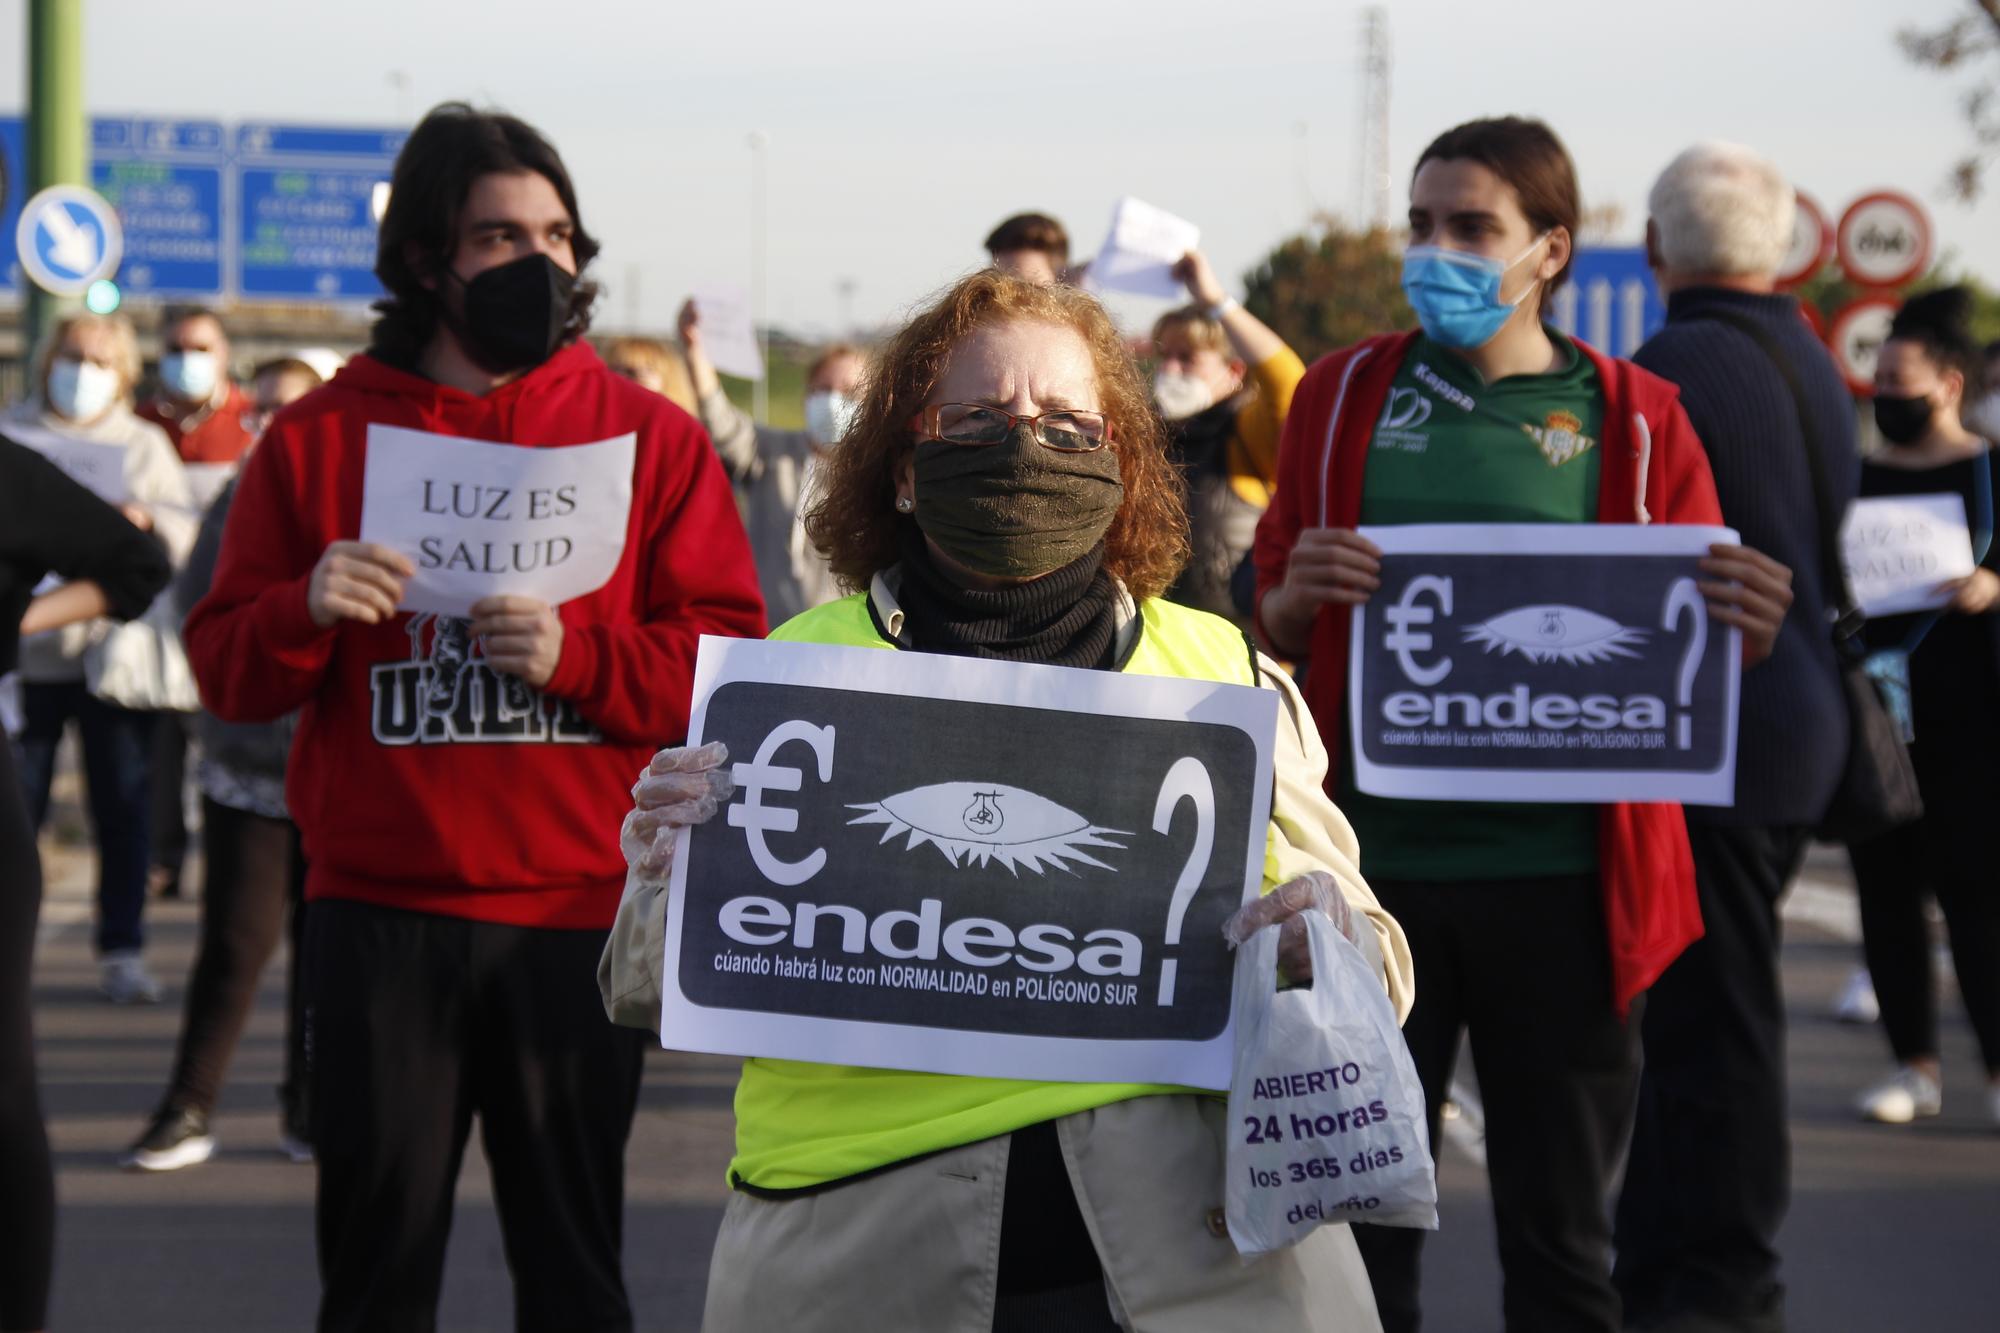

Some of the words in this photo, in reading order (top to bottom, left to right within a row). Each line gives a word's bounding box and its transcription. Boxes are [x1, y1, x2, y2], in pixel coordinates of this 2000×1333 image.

[1413, 362, 1476, 412] Kappa
[422, 479, 512, 521] LUZ
[527, 485, 577, 520] ES
[419, 536, 573, 573] SALUD
[1383, 684, 1666, 729] endesa
[1471, 735, 1490, 747] con
[1492, 732, 1564, 749] NORMALIDAD
[718, 896, 1143, 976] endesa
[714, 949, 770, 976] cúando
[774, 954, 817, 980] habrá
[821, 959, 843, 982] luz
[847, 968, 875, 985] con
[880, 965, 988, 996] NORMALIDAD
[992, 980, 1011, 997] en
[1015, 975, 1101, 1005] POLÍGONO
[1104, 983, 1138, 1006] SUR
[1253, 1062, 1361, 1100] ABIERTO
[1244, 1115, 1283, 1144] 24
[1290, 1100, 1388, 1141] horas
[1249, 1167, 1282, 1188] los
[1287, 1157, 1342, 1183] 365
[1350, 1145, 1404, 1175] días
[1287, 1199, 1325, 1224] del
